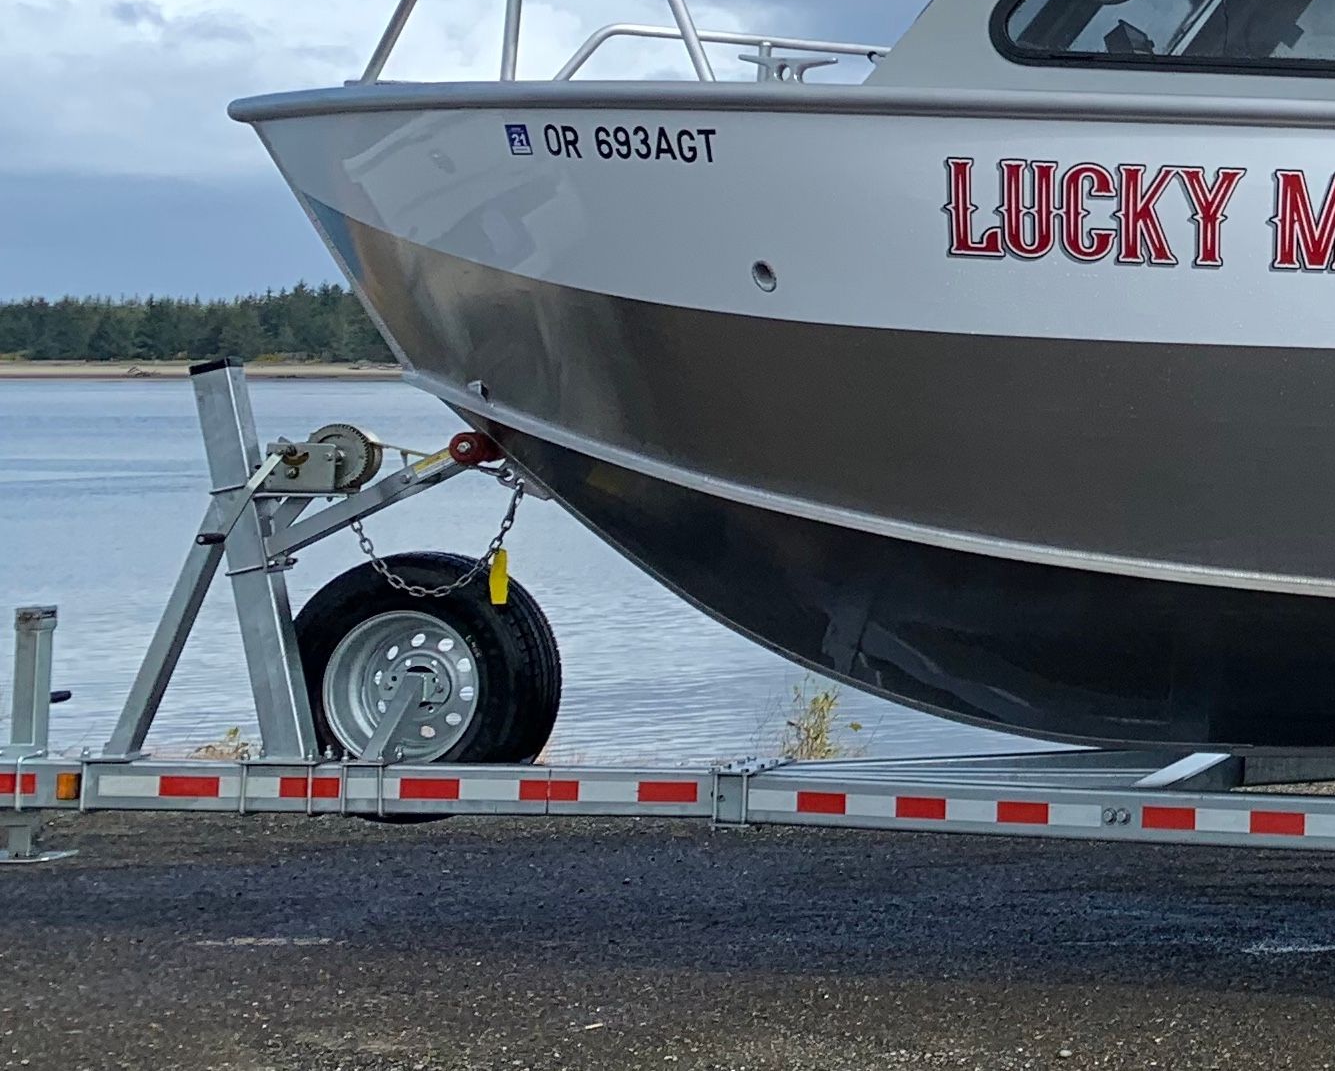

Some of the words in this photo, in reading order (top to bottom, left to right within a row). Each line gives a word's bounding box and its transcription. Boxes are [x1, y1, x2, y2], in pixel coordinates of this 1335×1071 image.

[511, 132, 528, 146] 21
[544, 123, 583, 159] OR
[594, 125, 717, 164] 693AGT
[942, 157, 1247, 268] LUCKY
